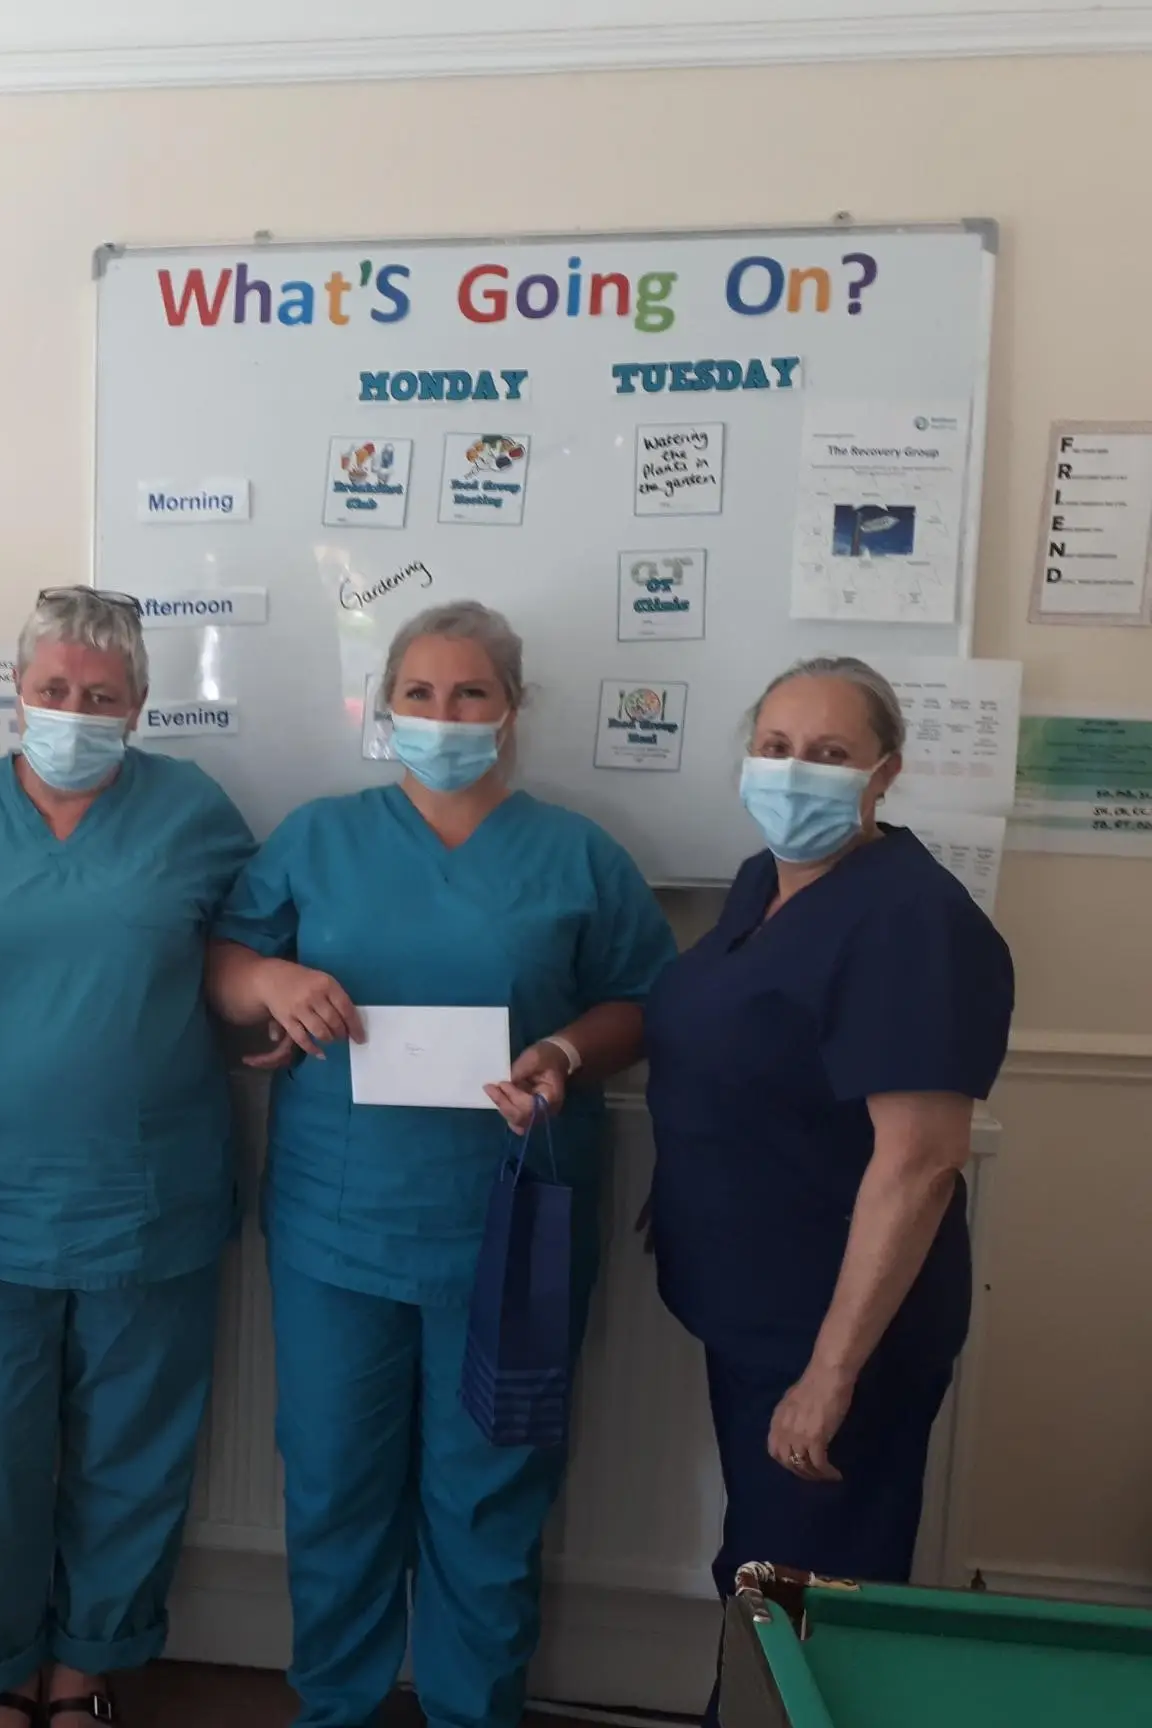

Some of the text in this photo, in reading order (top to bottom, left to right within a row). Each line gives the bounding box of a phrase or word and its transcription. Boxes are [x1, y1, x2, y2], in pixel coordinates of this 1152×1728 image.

[158, 252, 878, 332] What'S Going On?
[359, 369, 528, 401] MONDAY
[612, 356, 799, 394] TUESDAY
[828, 445, 940, 459] The Recovery Group
[148, 491, 234, 513] Morning
[340, 559, 433, 611] Gardening
[147, 708, 229, 728] Evening
